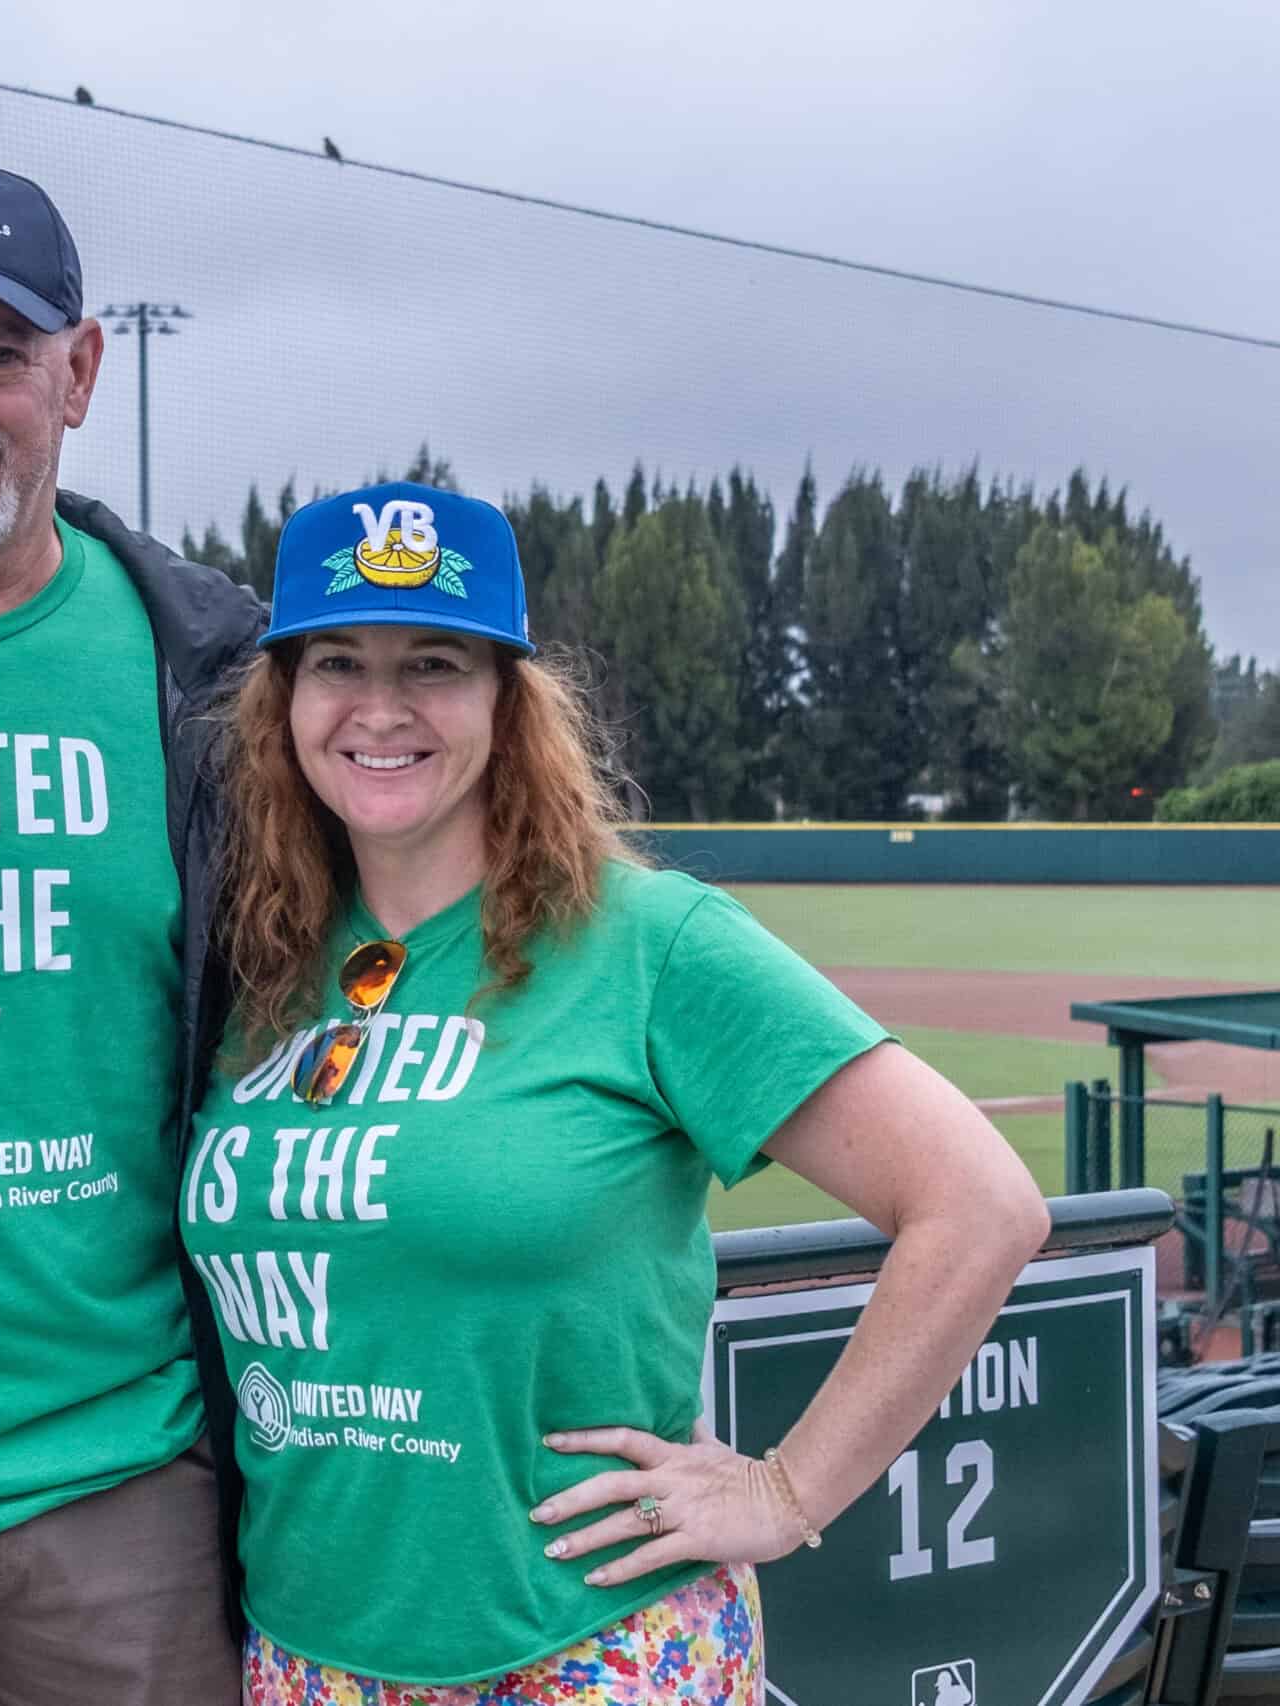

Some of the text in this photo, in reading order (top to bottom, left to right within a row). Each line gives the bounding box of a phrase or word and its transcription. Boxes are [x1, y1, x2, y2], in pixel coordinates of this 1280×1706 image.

[352, 499, 439, 553] VB
[39, 1132, 94, 1173] WAY
[187, 1124, 400, 1223] IS THE
[8, 1185, 62, 1208] River
[66, 1171, 118, 1201] County
[194, 1250, 331, 1351] WAY
[291, 1379, 423, 1423] UNITED WAY
[344, 1426, 386, 1452] River
[390, 1432, 462, 1463] County
[887, 1438, 996, 1582] 12
